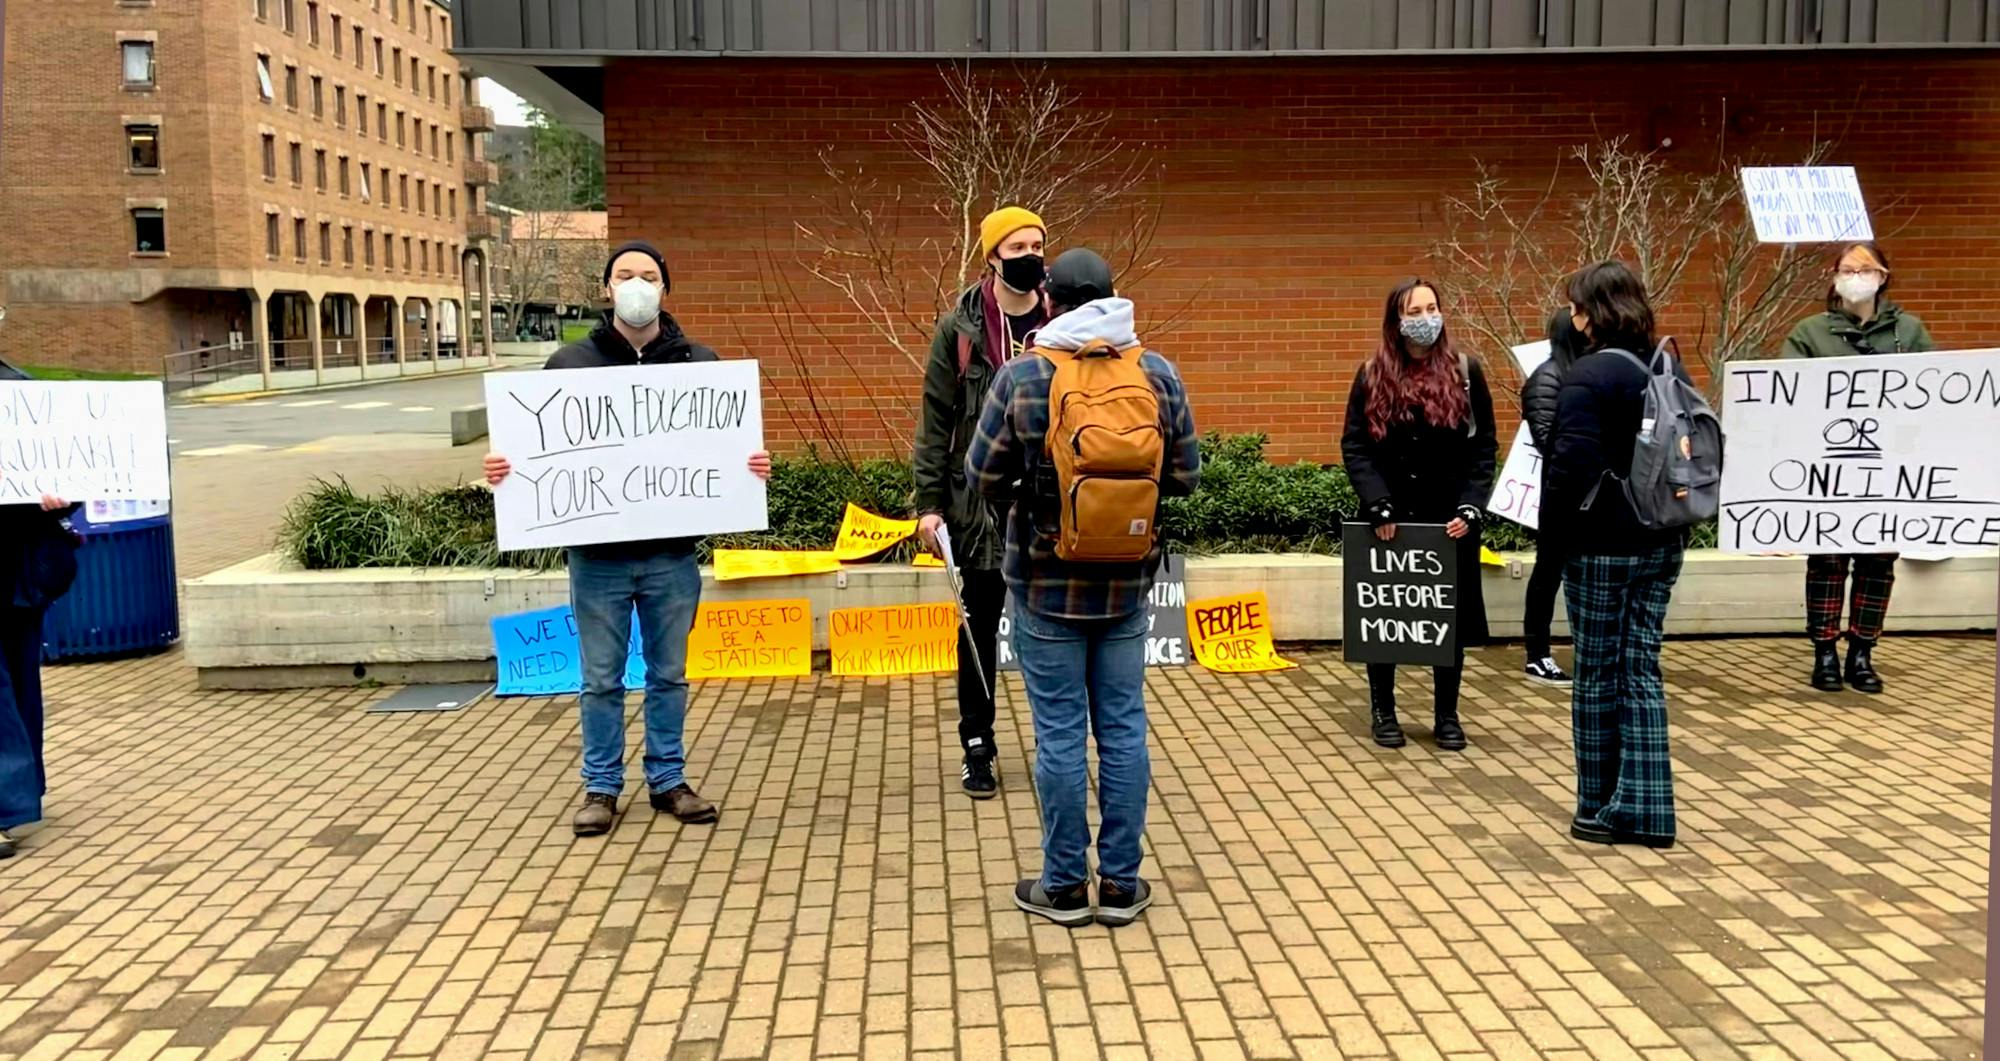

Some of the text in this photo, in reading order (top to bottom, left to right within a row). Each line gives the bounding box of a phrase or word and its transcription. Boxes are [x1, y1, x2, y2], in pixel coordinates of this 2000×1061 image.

[1732, 368, 2000, 409] IN PERSON
[509, 385, 747, 451] YOUR EDUCATION
[1823, 418, 1882, 451] OR
[515, 465, 721, 521] YOUR CHOICE
[1770, 459, 1958, 499] ONLINE
[1726, 506, 2000, 548] YOUR CHOICE
[1370, 548, 1443, 575] LIVES
[1357, 582, 1455, 609] BEFORE
[707, 606, 802, 628] REFUSE TO
[832, 606, 957, 637] OUR TUITION
[1195, 601, 1263, 640] PEOPLE
[1361, 617, 1449, 646] MONEY
[514, 619, 557, 646] WE
[721, 630, 766, 648] BE A
[701, 647, 799, 671] STATISTIC
[834, 648, 875, 673] YOUR
[1215, 639, 1260, 660] OVER
[509, 650, 568, 682] NEED
